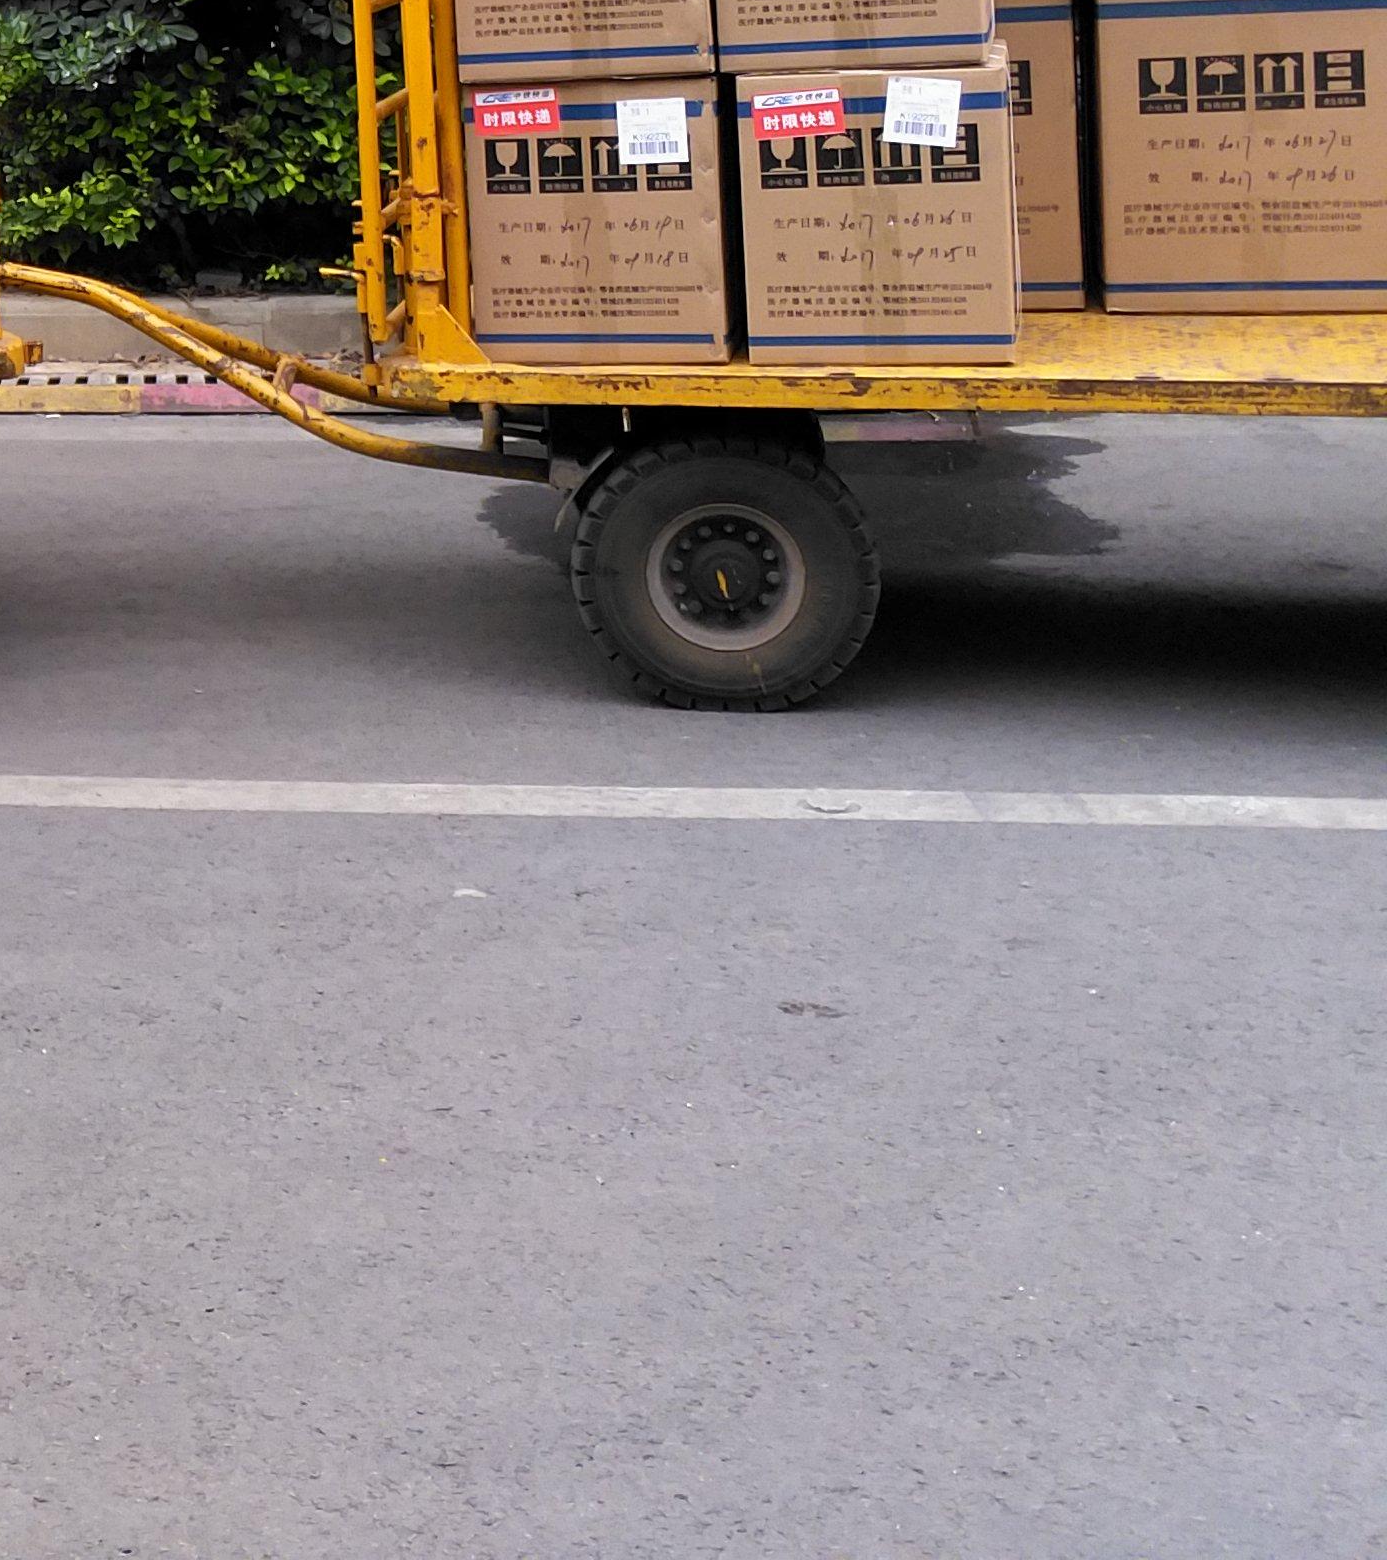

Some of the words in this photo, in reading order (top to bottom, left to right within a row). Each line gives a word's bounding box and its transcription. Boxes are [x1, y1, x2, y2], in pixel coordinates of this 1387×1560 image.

[483, 108, 552, 127] 时限快递
[763, 110, 836, 131] 时限快递
